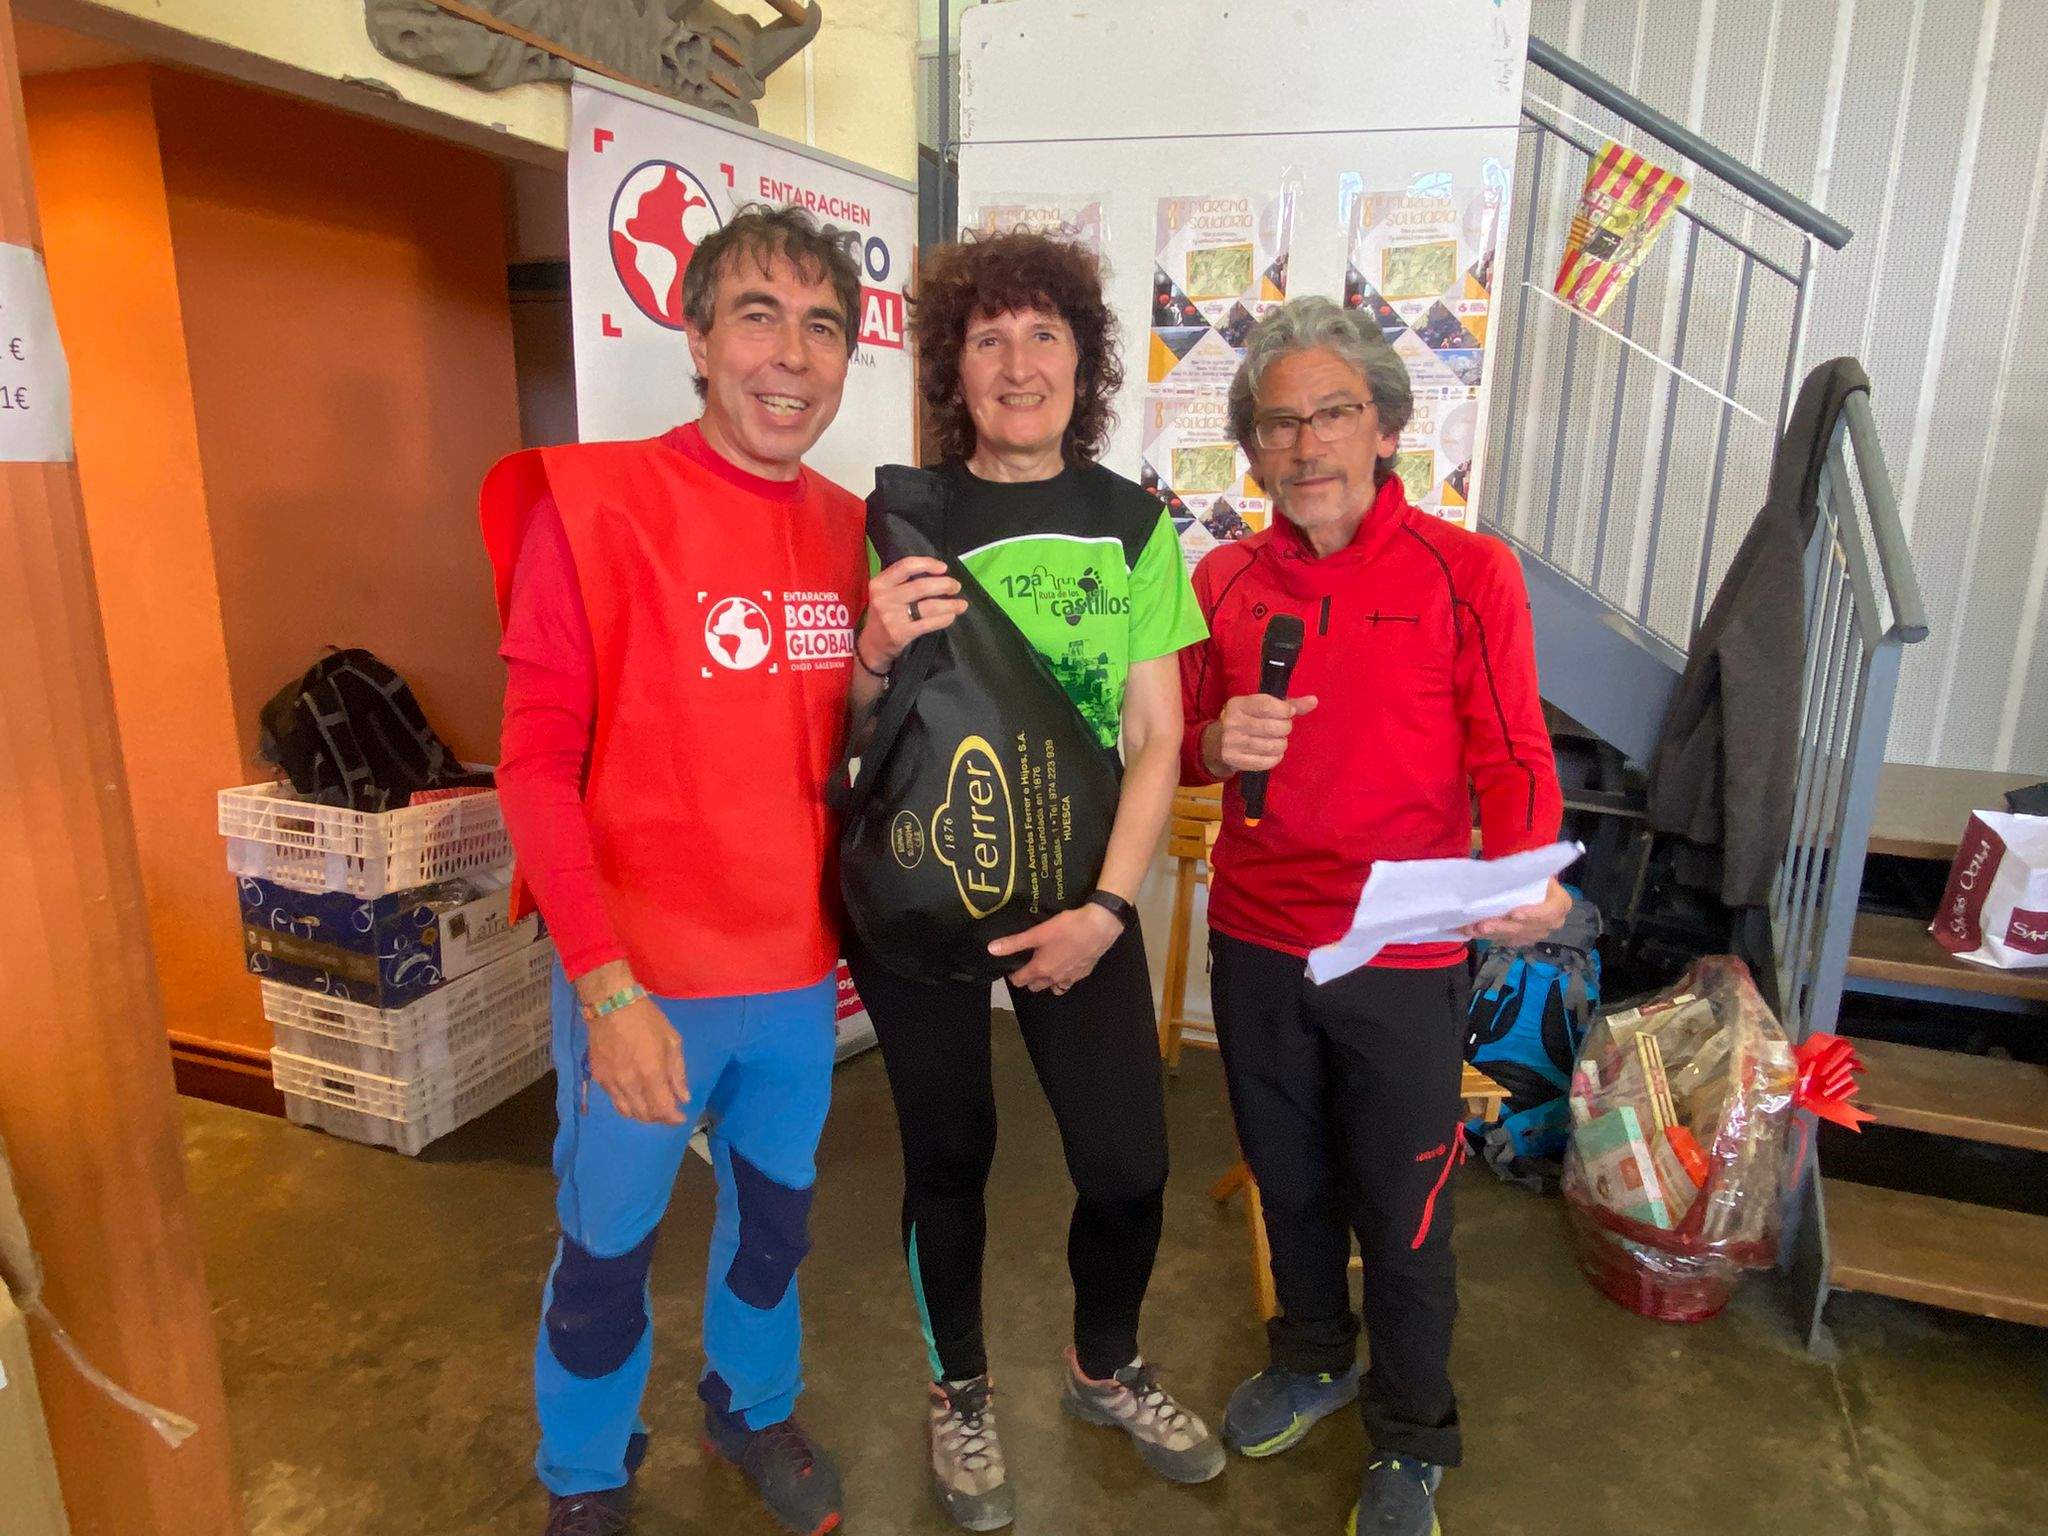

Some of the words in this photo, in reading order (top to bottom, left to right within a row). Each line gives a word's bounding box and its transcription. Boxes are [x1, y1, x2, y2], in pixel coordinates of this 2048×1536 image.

[760, 176, 871, 227] ENTARACHEN
[783, 591, 839, 602] ENTARACHEN
[1050, 586, 1130, 617] castillos
[1057, 590, 1067, 598] de
[1068, 589, 1080, 598] los
[784, 603, 849, 628] BOSCO
[789, 633, 854, 656] GLOBAL
[1047, 760, 1056, 779] 223
[1037, 792, 1043, 806] en
[1048, 782, 1057, 800] 974
[966, 760, 1000, 894] Ferrer
[1024, 797, 1033, 829] Ferrer
[1061, 795, 1072, 841] HUESCA
[944, 818, 956, 850] 1876
[1036, 807, 1047, 851] Fundada
[1025, 831, 1037, 869] Andrés
[1040, 853, 1049, 879] Casa
[1054, 868, 1065, 900] Ronda
